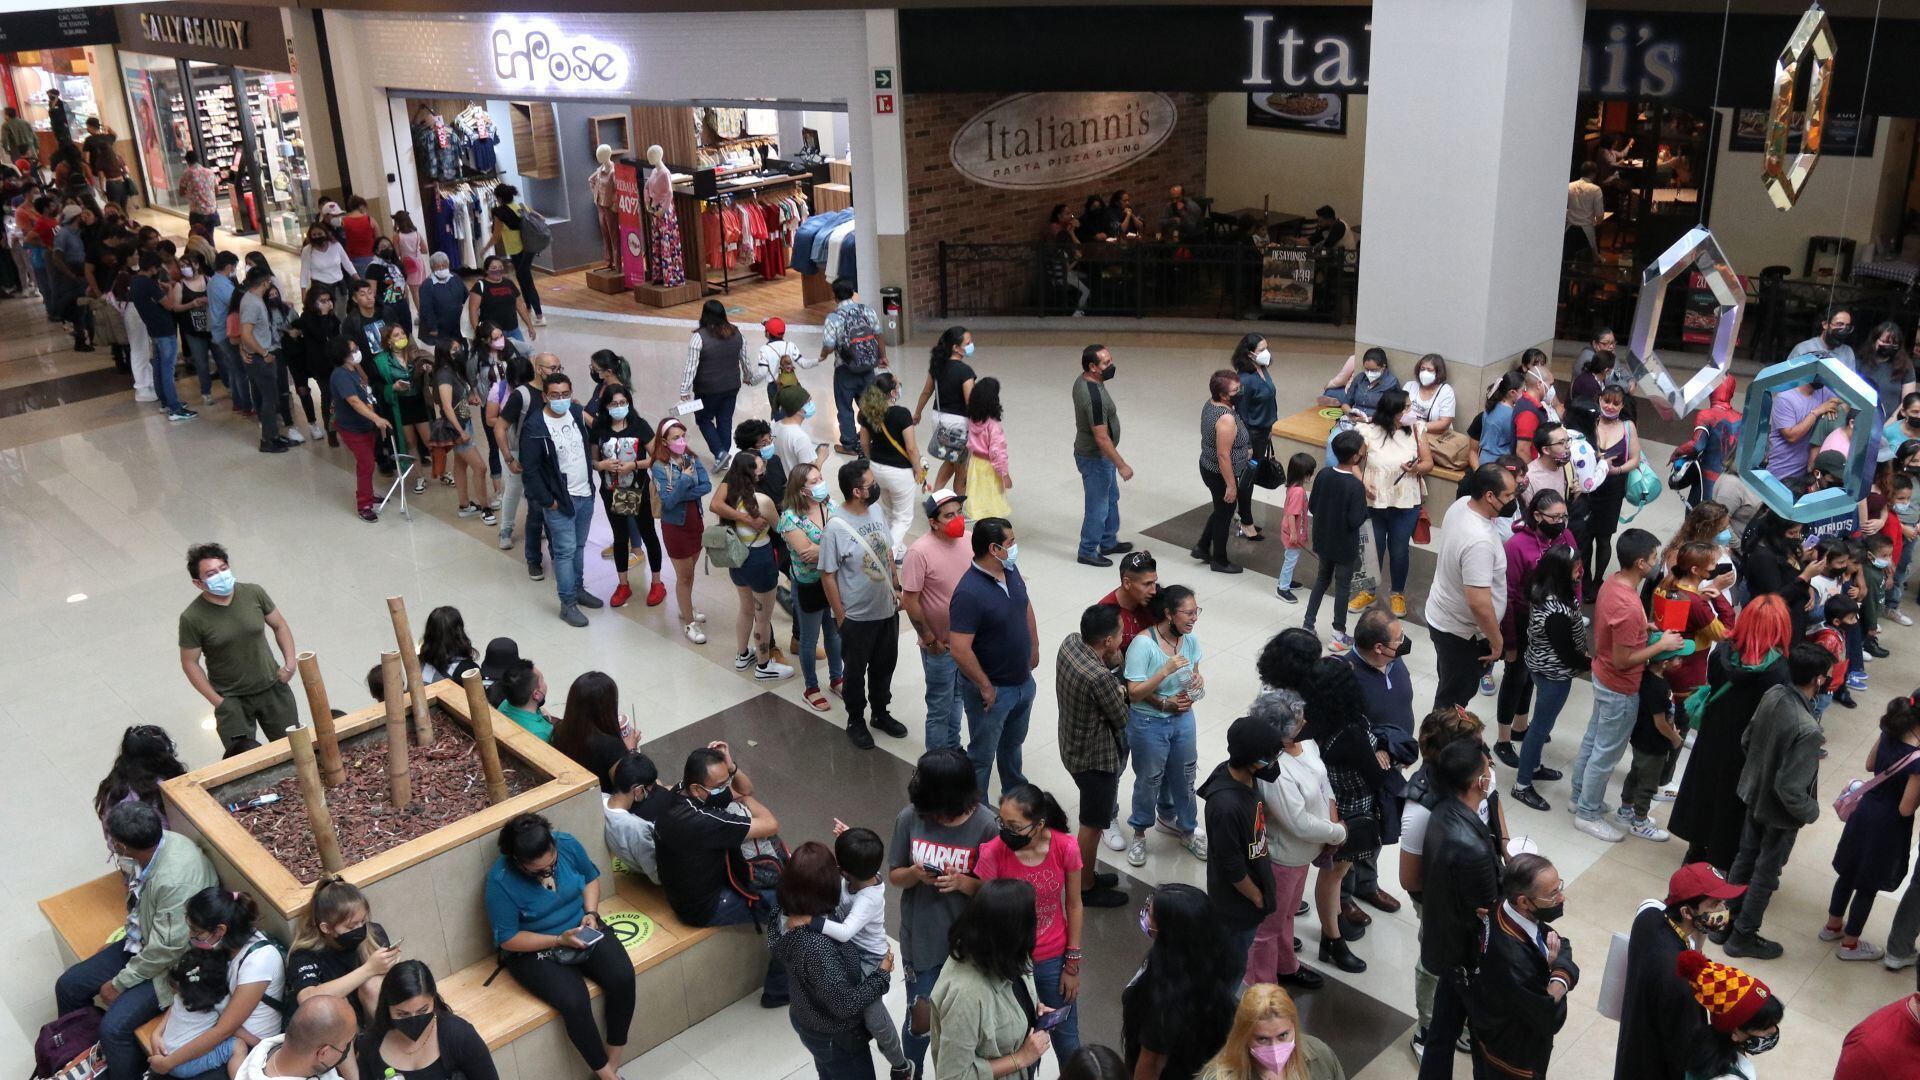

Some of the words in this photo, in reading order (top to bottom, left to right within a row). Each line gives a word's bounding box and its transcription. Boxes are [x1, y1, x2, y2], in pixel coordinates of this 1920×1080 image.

[140, 13, 181, 44] SALLY
[183, 16, 243, 50] BEAUTY
[1243, 15, 1372, 86] Ita
[983, 101, 1151, 163] Italianni's
[993, 162, 1041, 178] PASTA
[1048, 151, 1090, 168] PIZZA
[1108, 143, 1141, 157] VINO
[1271, 249, 1308, 262] DESAYUNOS
[912, 840, 971, 874] MARVEL
[609, 913, 641, 921] SALUD
